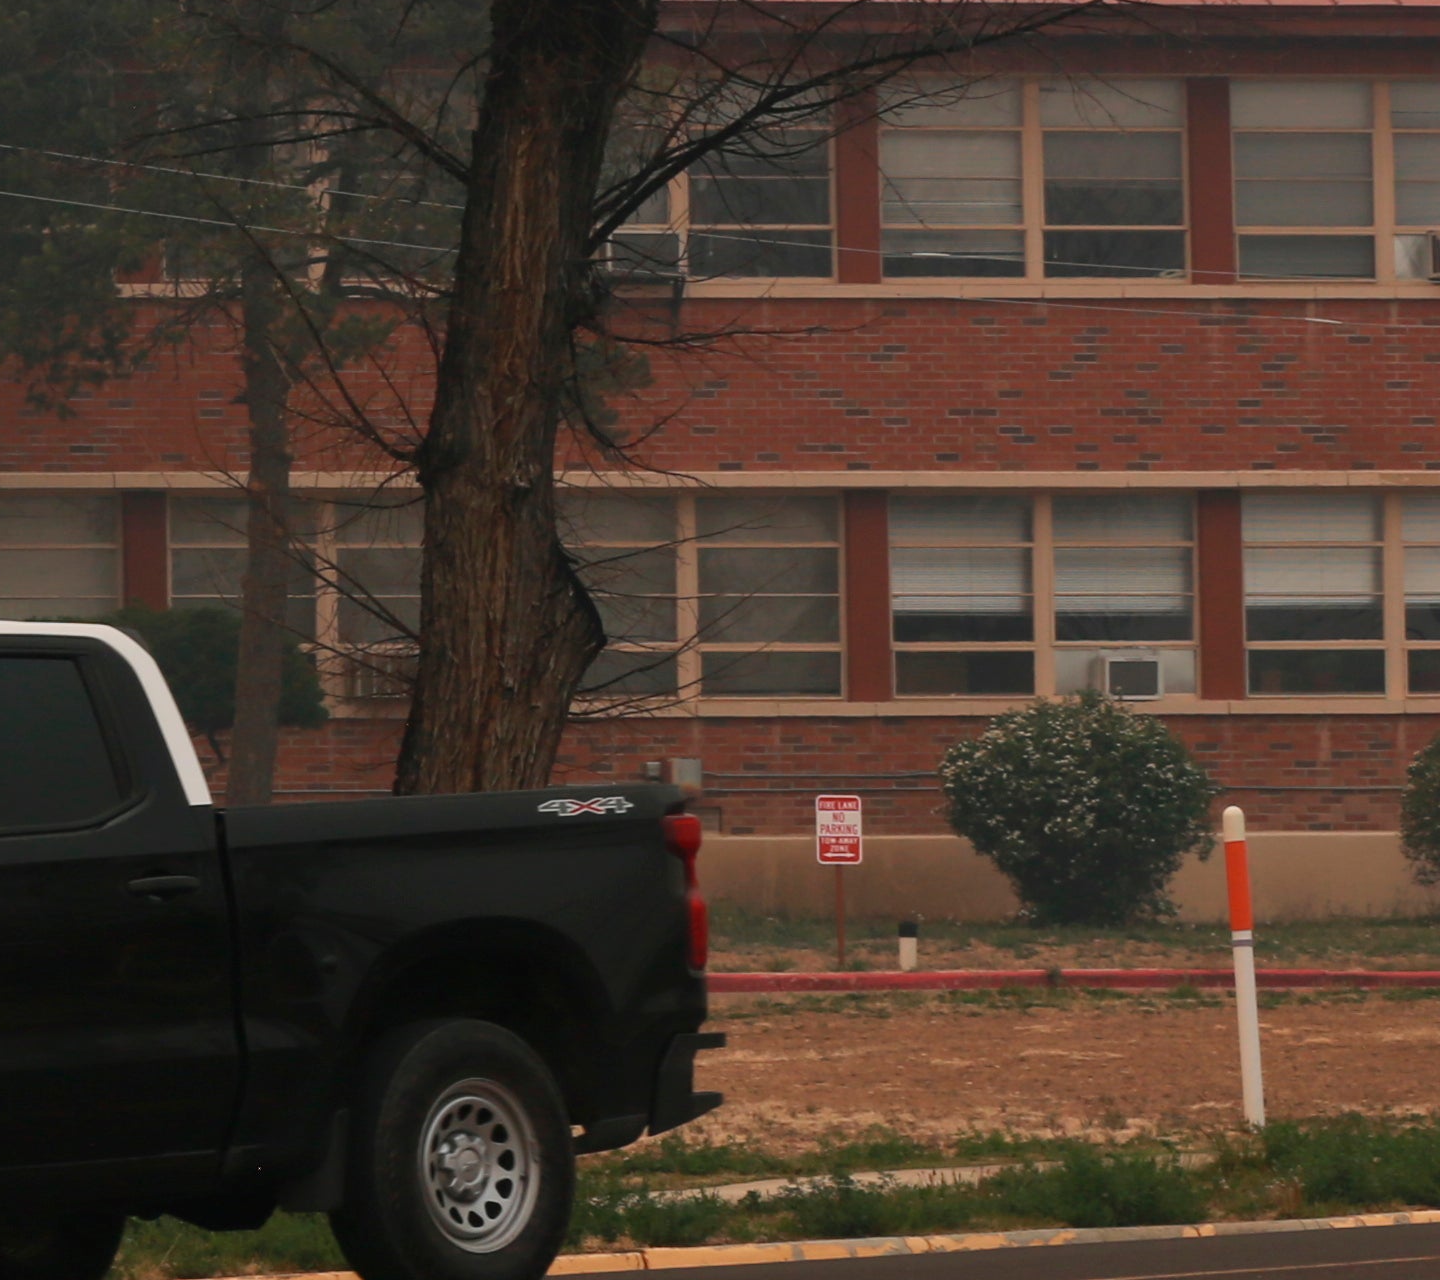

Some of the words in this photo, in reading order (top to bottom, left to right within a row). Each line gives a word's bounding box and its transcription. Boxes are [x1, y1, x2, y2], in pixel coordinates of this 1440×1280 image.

[819, 801, 835, 810] FIRE
[838, 800, 857, 810] LANE
[832, 812, 845, 823] NO
[820, 824, 858, 835] PARKING
[830, 845, 849, 853] ZONE
